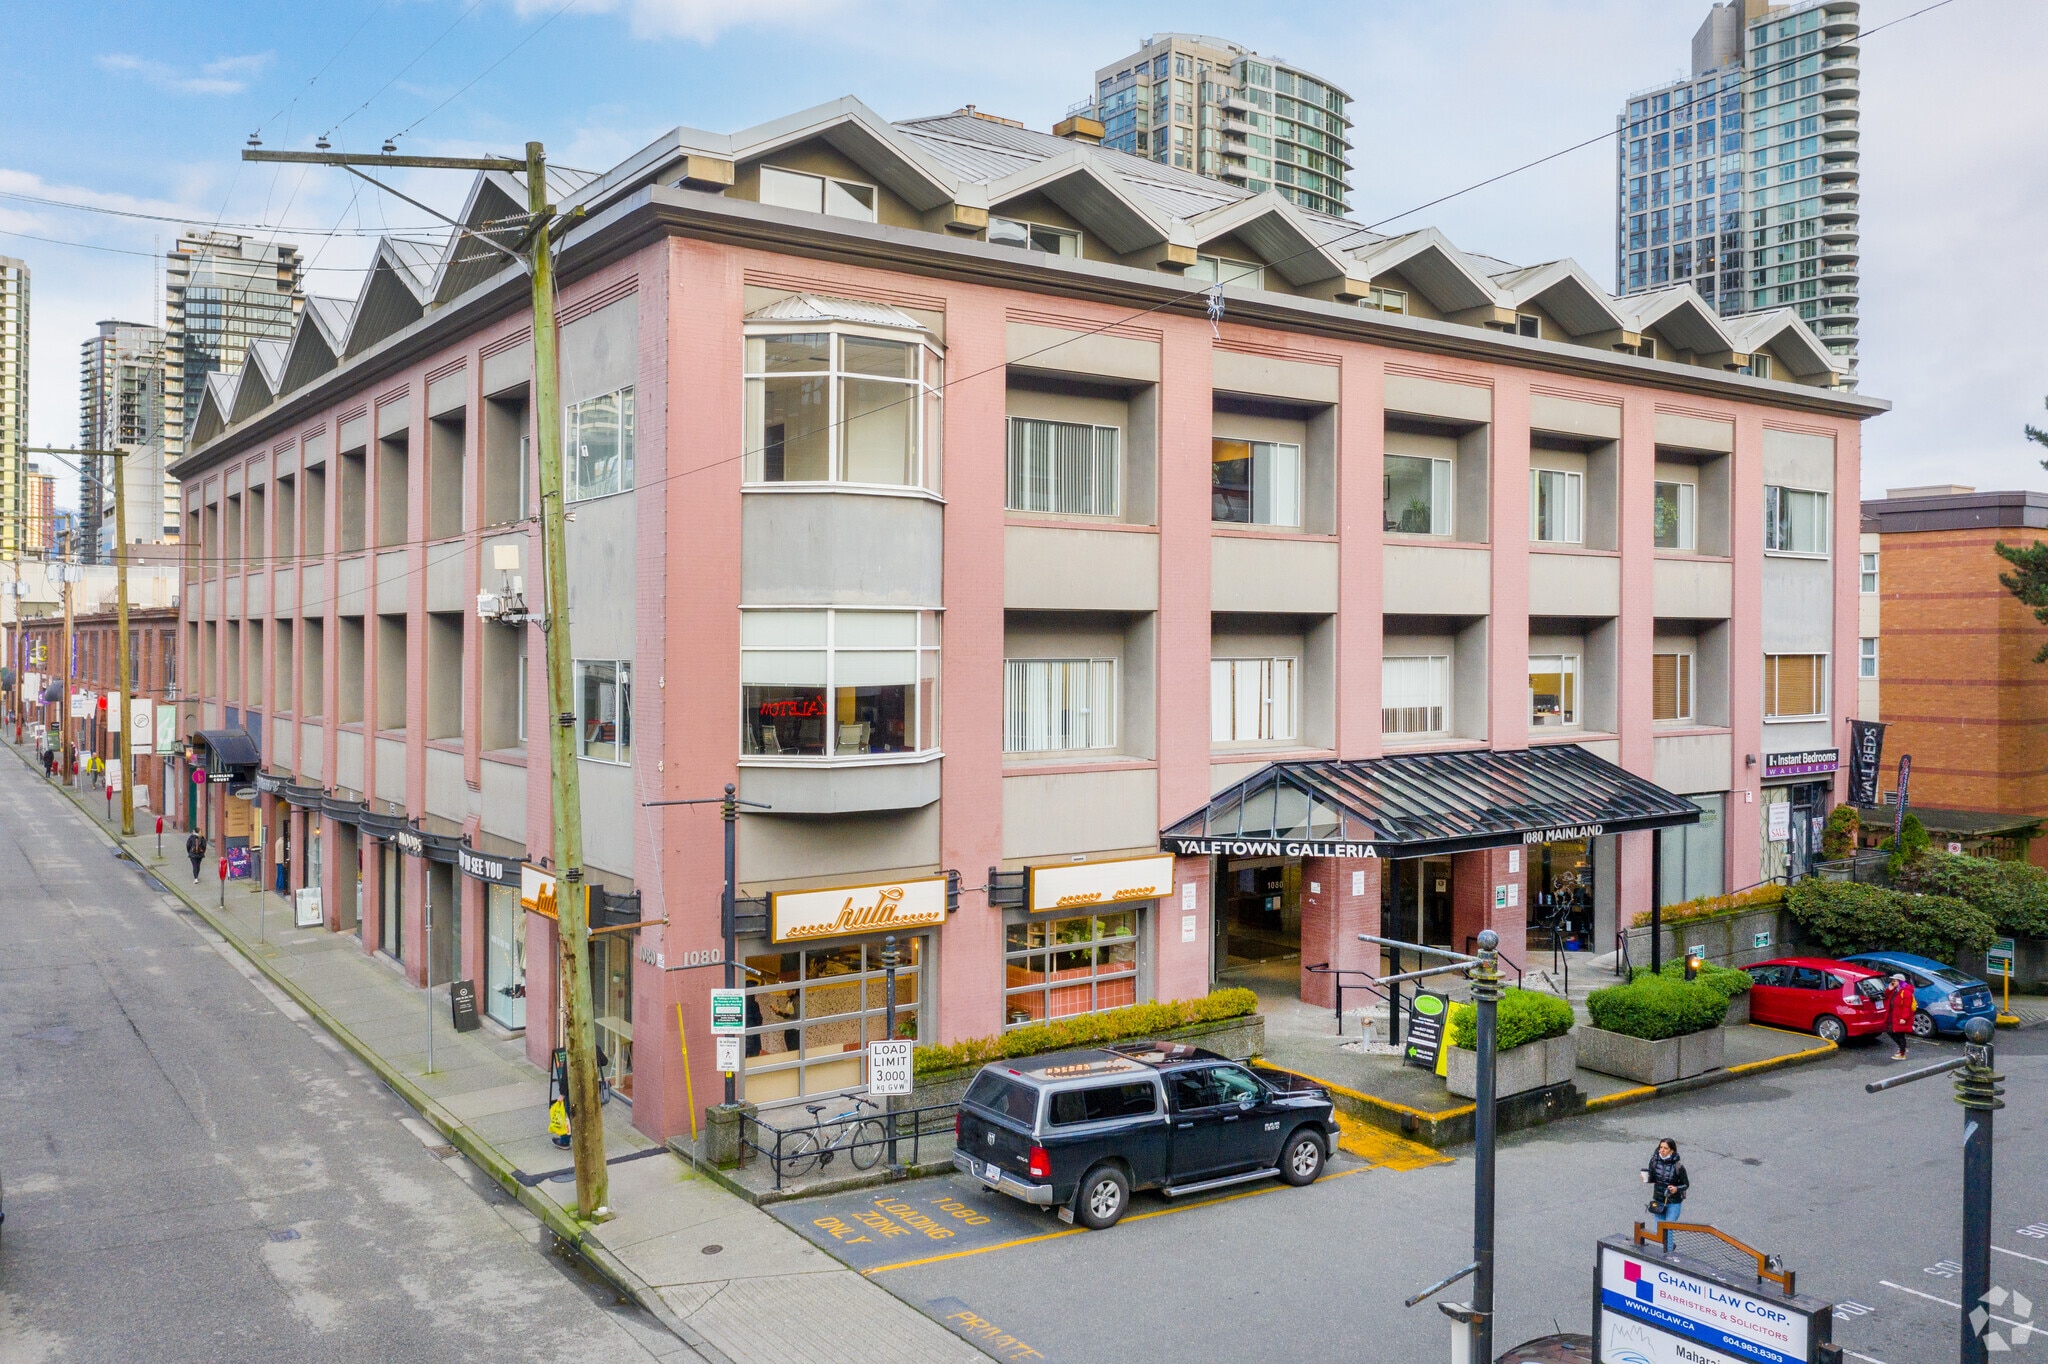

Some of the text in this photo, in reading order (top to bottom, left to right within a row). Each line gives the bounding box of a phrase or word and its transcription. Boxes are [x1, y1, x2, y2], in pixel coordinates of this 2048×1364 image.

[1778, 752, 1837, 766] Instant Bedrooms
[1861, 727, 1877, 803] WALL BEDS
[1769, 764, 1836, 776] WALL BEDS
[1523, 825, 1603, 844] 1080 MAINLAND
[1771, 827, 1786, 837] SALE
[1177, 840, 1378, 858] YALETOWN GALLERIA
[471, 857, 484, 875] SEE
[485, 860, 503, 879] YOU
[684, 948, 720, 966] 1080
[874, 1045, 907, 1055] LOAD
[874, 1057, 907, 1067] LIMIT
[876, 1070, 906, 1082] 3,000
[877, 1083, 885, 1092] kg
[874, 1198, 955, 1240] LOADING
[931, 1197, 991, 1226] 1080
[813, 1217, 873, 1244] ONLY
[851, 1210, 911, 1239] ZONE
[1658, 1271, 1790, 1327] GHANI LAW CORP.
[1625, 1299, 1695, 1331] WWW.UGLAW.CA
[1659, 1290, 1789, 1343] BARRISTERS & SOLICITORS
[946, 1310, 1045, 1361] PRIVATE
[1676, 1344, 1721, 1364] Mahara
[1722, 1335, 1783, 1363] 604.983.8393
